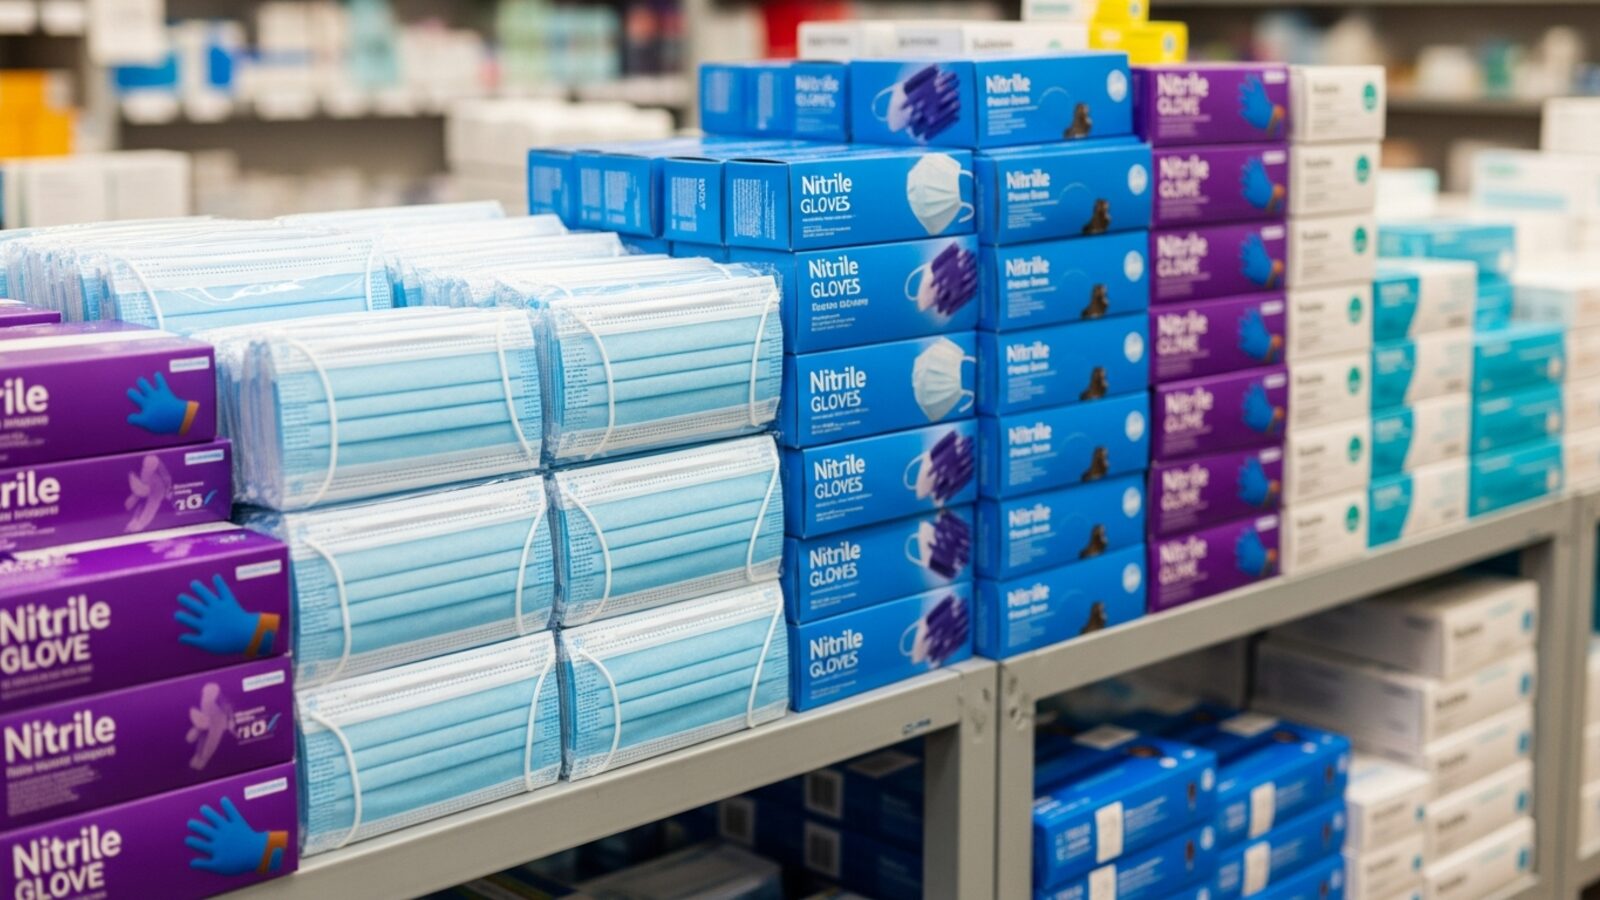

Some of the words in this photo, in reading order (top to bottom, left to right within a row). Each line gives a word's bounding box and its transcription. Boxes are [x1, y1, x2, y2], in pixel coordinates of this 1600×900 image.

[985, 73, 1031, 94] Nitrile
[1157, 71, 1209, 98] Nitrile
[802, 172, 852, 195] Nitrile
[1006, 169, 1050, 189] Nitrile
[800, 196, 851, 214] GLOVES
[808, 255, 859, 279] Nitrile
[1005, 256, 1050, 277] Nitrile
[811, 278, 861, 298] GLOVES
[1007, 341, 1050, 363] Nitrile
[810, 366, 866, 394] Nitrile
[811, 390, 861, 413] GLOVES
[1009, 422, 1052, 445] Nitrile
[814, 454, 865, 481] Nitrile
[815, 476, 863, 500] GLOVES
[810, 541, 861, 570] Nitrile
[809, 562, 858, 588] GLOVES
[0, 595, 111, 646] Nitrile
[0, 633, 91, 674] GLOVE
[810, 629, 863, 661] Nitrile
[4, 710, 116, 763] Nitrile
[13, 825, 121, 879] Nitrile
[14, 861, 105, 900] GLOVE
